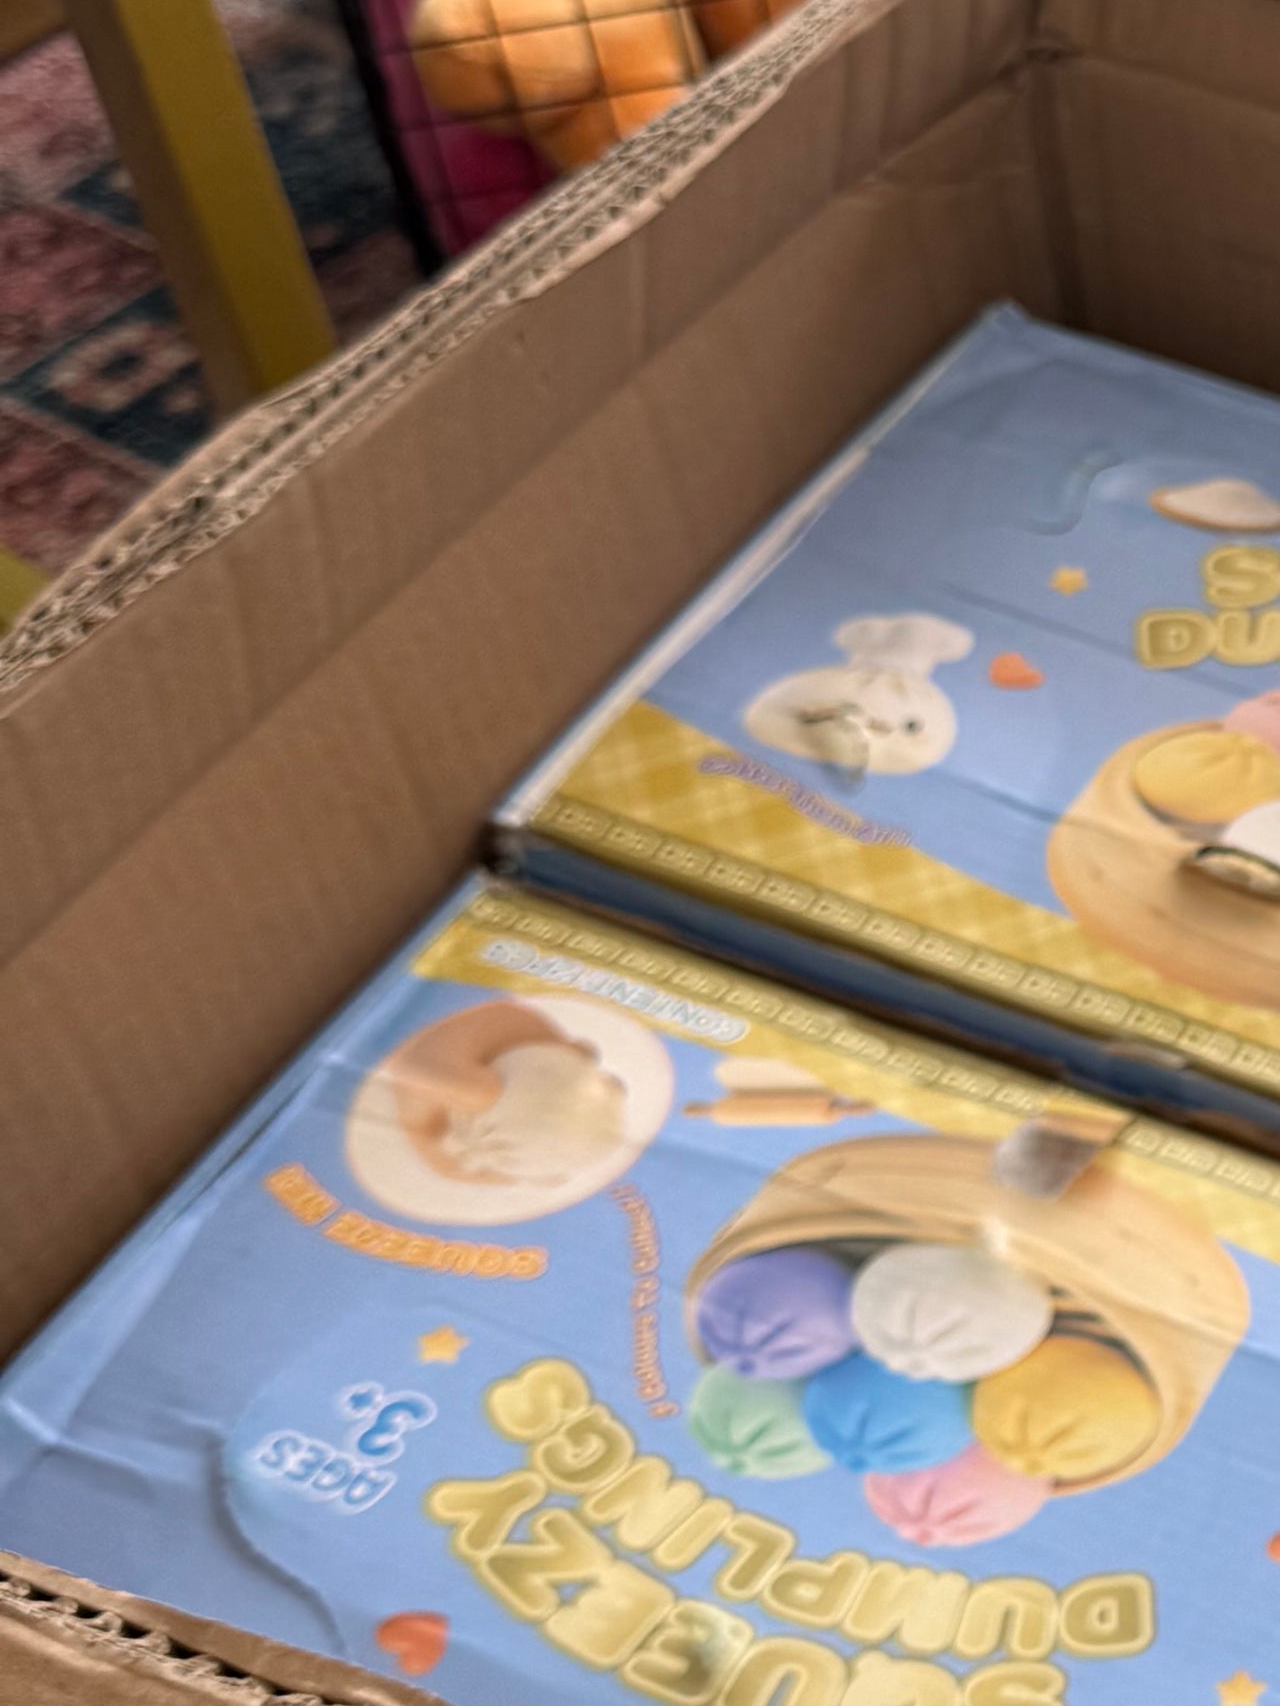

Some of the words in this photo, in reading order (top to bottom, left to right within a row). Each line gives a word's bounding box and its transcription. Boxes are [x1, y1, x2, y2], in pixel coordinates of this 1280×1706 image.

[341, 1382, 436, 1463] 3+
[256, 1430, 397, 1513] AGES
[486, 1359, 1153, 1657] DUMPLINGS
